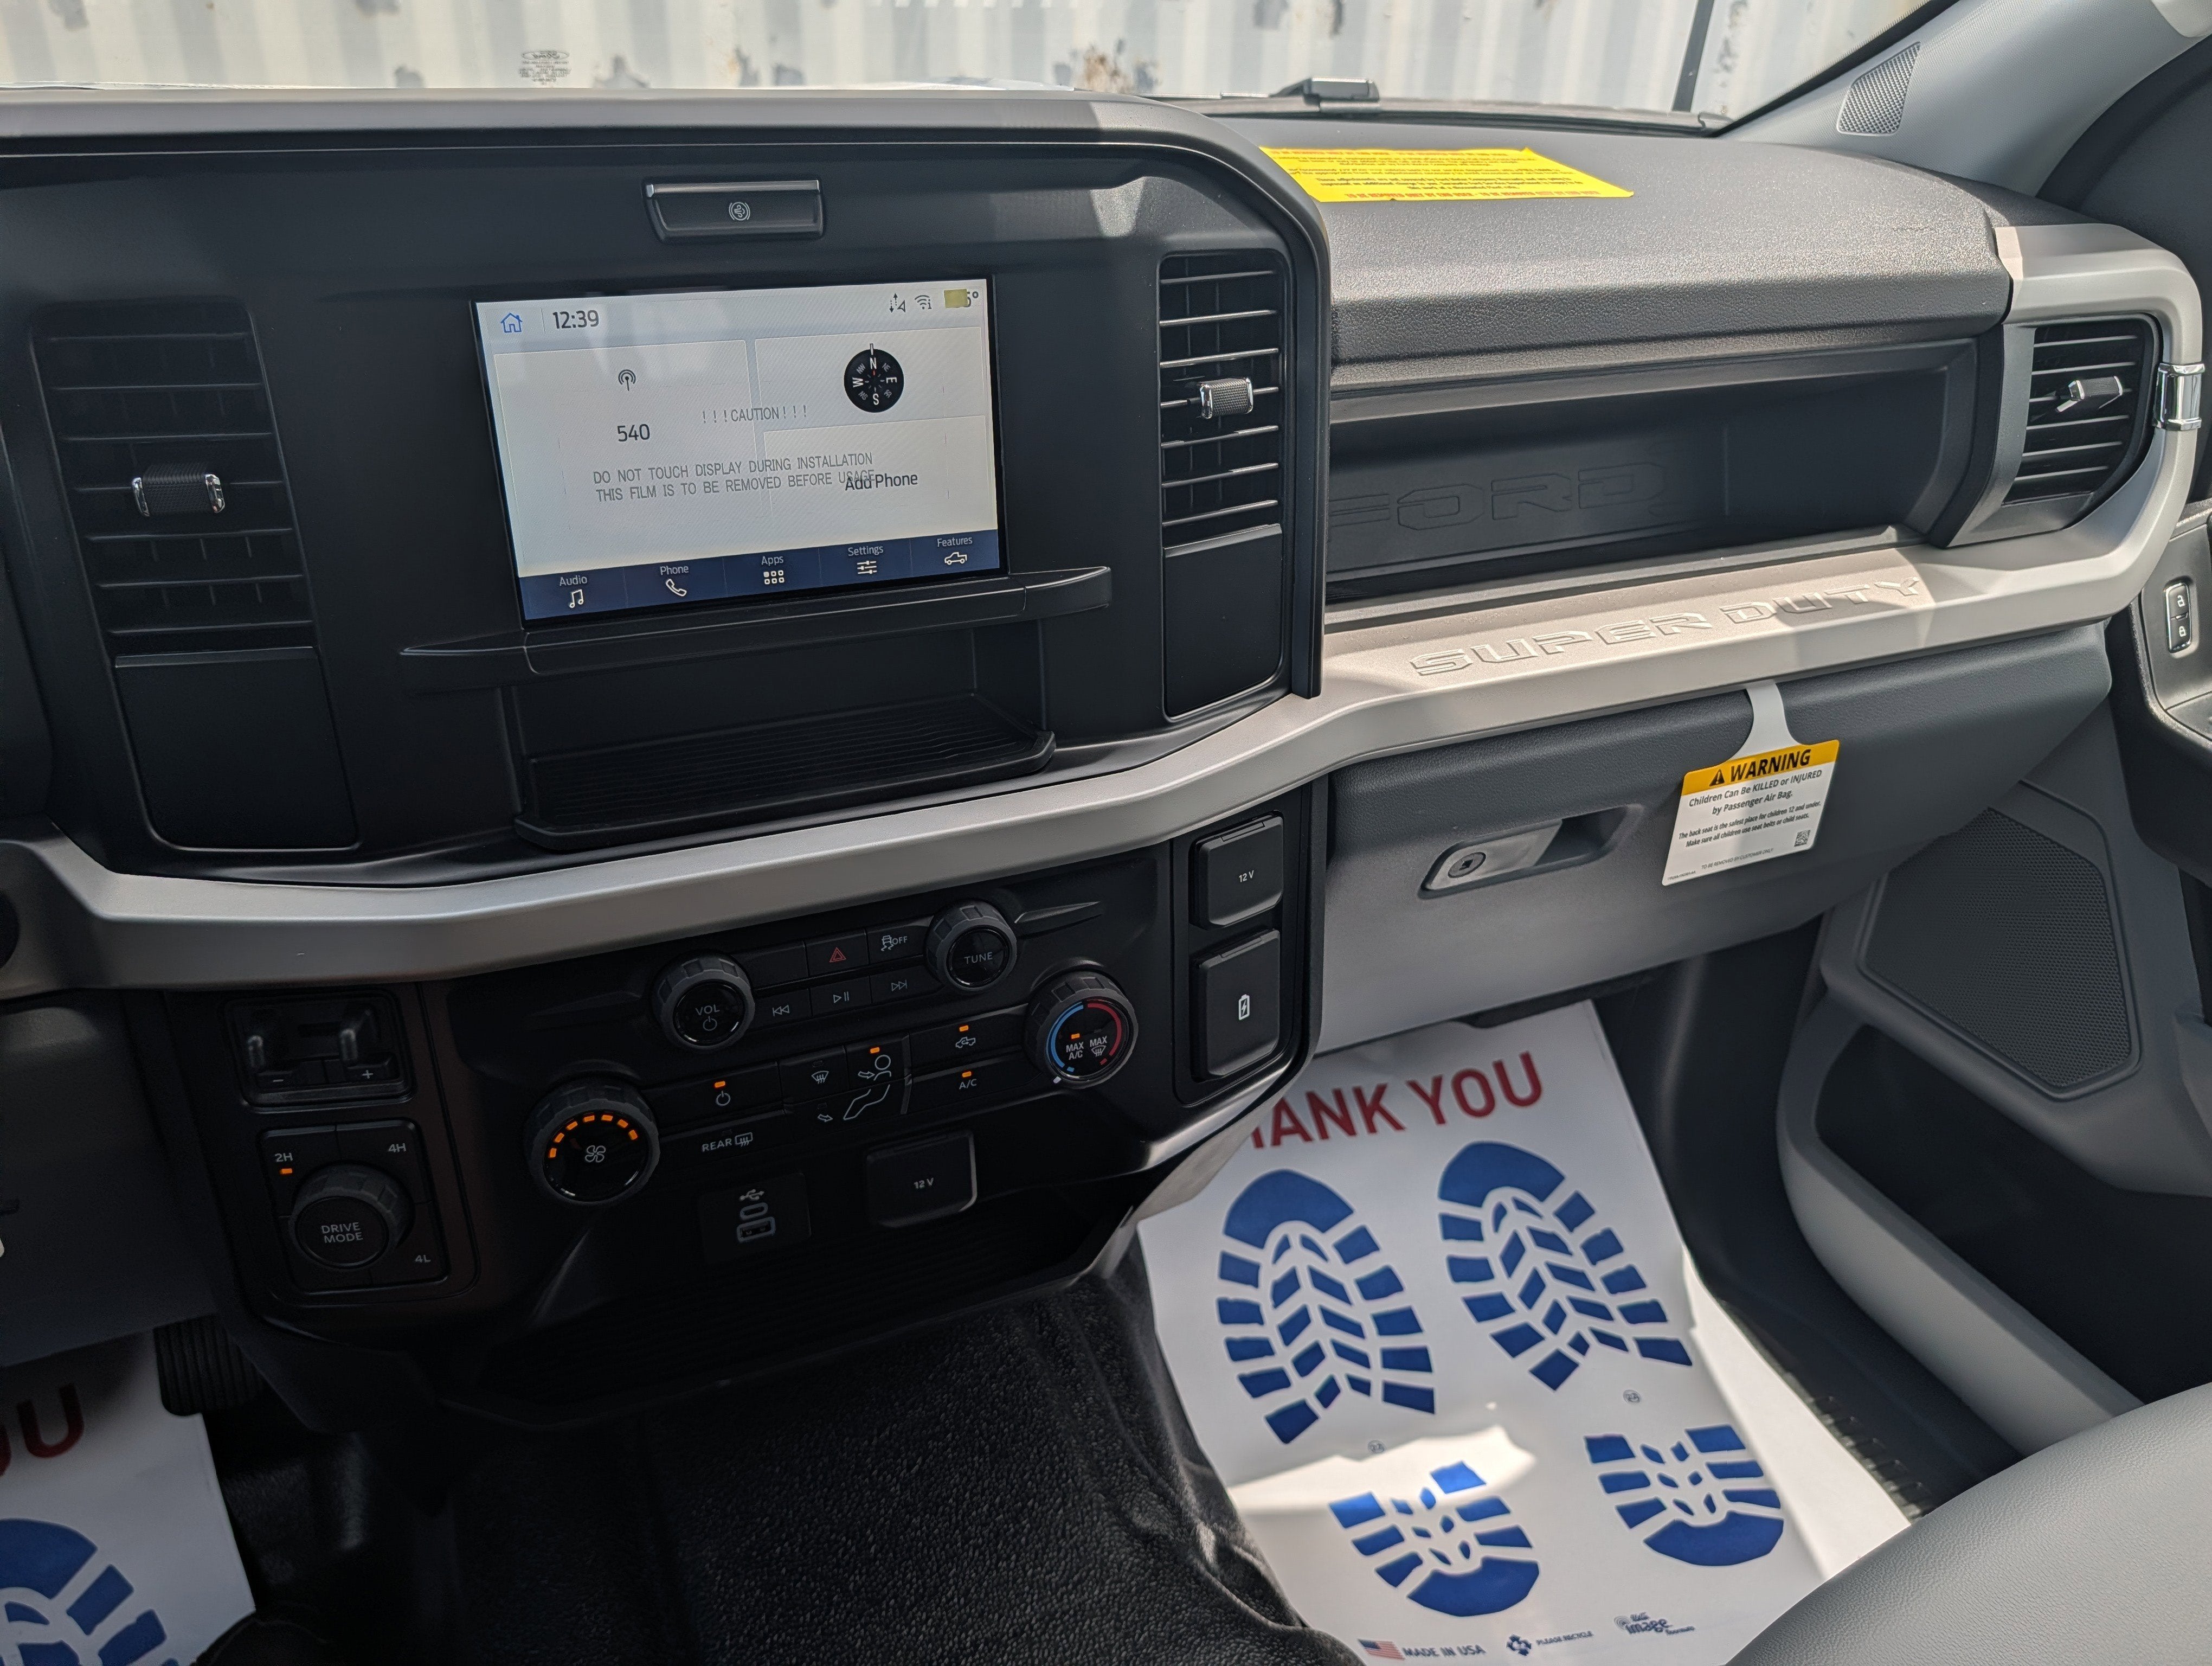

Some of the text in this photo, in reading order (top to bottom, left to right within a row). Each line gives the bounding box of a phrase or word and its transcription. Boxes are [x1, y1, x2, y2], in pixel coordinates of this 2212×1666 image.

[552, 310, 599, 329] 12:39
[870, 357, 877, 370] N
[873, 393, 879, 406] S
[617, 424, 650, 441] 540
[593, 452, 873, 484] DO NOT TOUCH DISPLAY DURING INSTALLATION
[596, 469, 874, 502] THIS FILM IS TO BE REMOVED BEFORE USAGE
[845, 473, 918, 491] Add Phone
[937, 536, 973, 547] Features
[847, 545, 884, 557] Settings
[761, 555, 784, 566] Apps
[660, 565, 689, 575] Phone
[559, 575, 587, 587] Audio
[1409, 576, 1921, 676] SUPER DUTY
[1730, 748, 1811, 783] WARNING
[1689, 793, 1722, 807] Children
[1724, 790, 1738, 799] Can
[1741, 786, 1751, 794] Be
[1752, 779, 1779, 792] KILLED
[1790, 770, 1822, 783] INJURED
[1712, 790, 1792, 816] by Passenger Air Bag.
[1689, 828, 1701, 837] back
[1729, 818, 1744, 827] safest
[1744, 816, 1758, 825] place
[1767, 809, 1787, 818] children
[1795, 803, 1805, 811] and
[1686, 839, 1700, 847] Make
[1721, 829, 1741, 838] children
[1783, 815, 1795, 824] child
[1238, 870, 1254, 882] 12 V
[892, 935, 908, 945] OFF
[964, 951, 993, 964] TUNE
[695, 1004, 720, 1016] VOL
[1066, 1041, 1084, 1053] MAX
[1090, 1035, 1107, 1047] MAX
[1069, 1050, 1083, 1060] A/C
[959, 1079, 977, 1090] A/C
[1251, 1050, 1542, 1149] ANK YOU
[388, 1143, 407, 1153] 4H
[702, 1138, 732, 1152] REAR
[274, 1152, 293, 1162] 2H
[914, 1177, 934, 1189] 12 V
[321, 1222, 361, 1234] DRIVE
[324, 1232, 363, 1244] MODE
[415, 1254, 431, 1263] 4L
[1402, 1644, 1486, 1657] MADE IN USA
